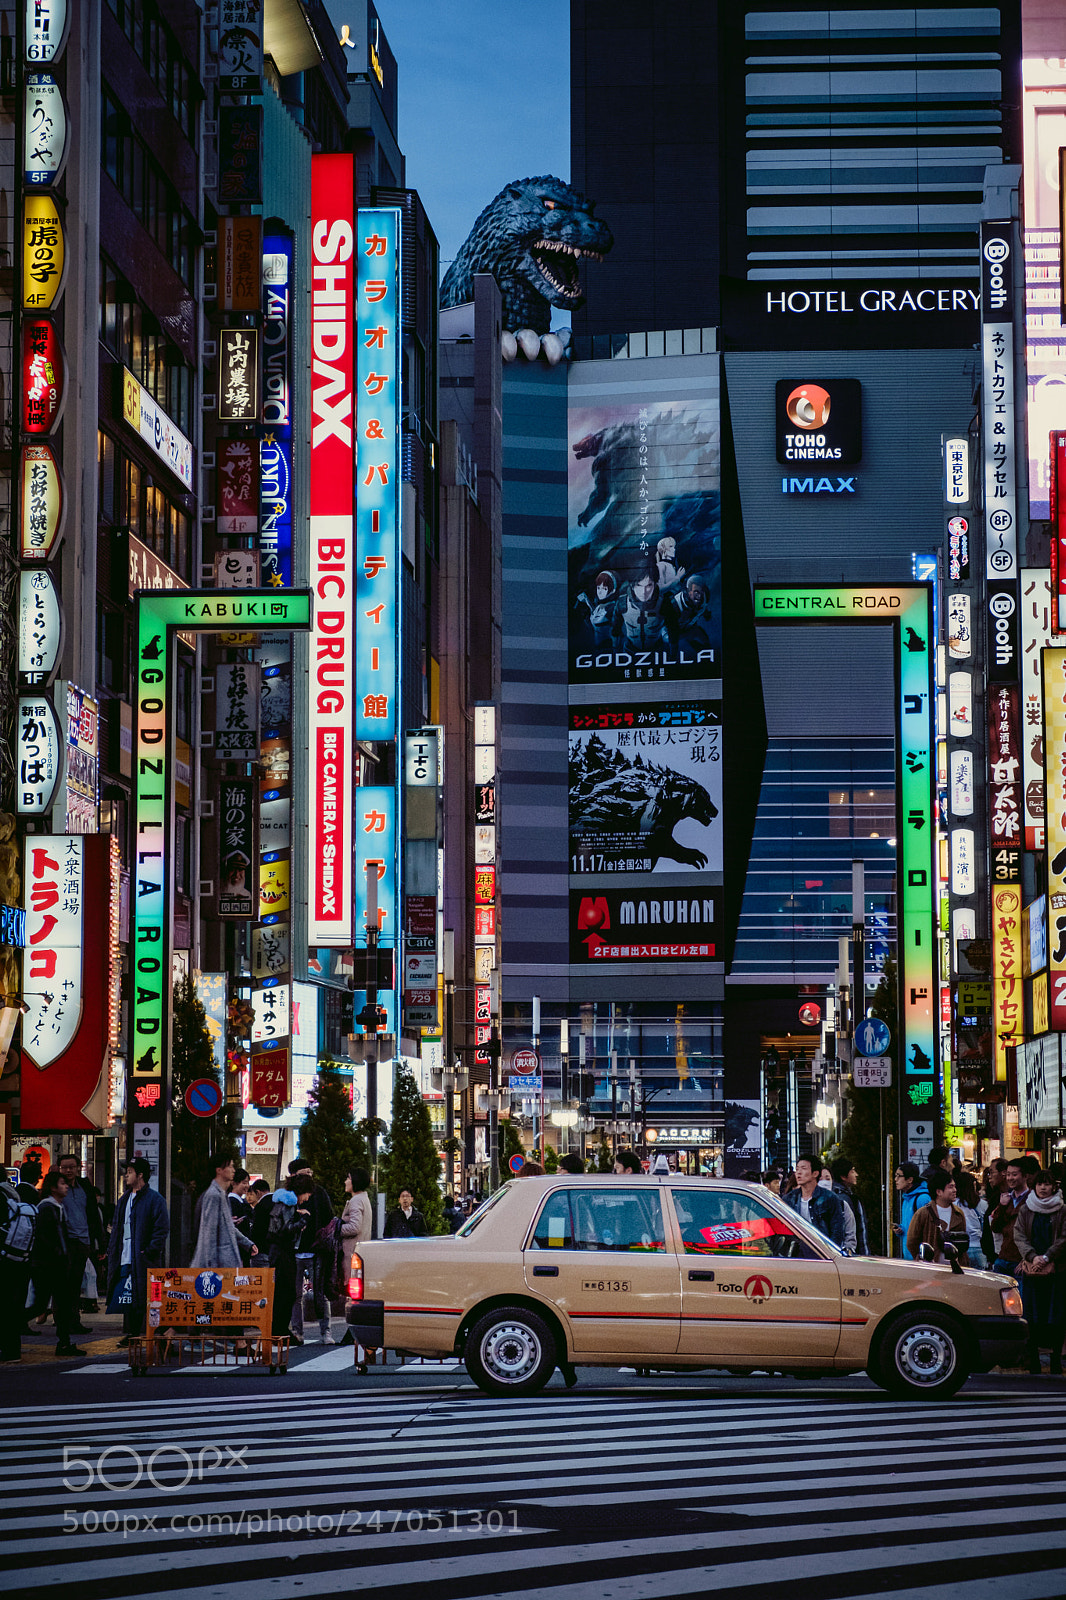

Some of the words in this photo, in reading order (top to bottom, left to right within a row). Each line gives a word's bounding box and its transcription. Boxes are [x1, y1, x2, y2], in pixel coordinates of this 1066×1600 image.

[27, 44, 54, 59] 6F
[231, 76, 247, 88] 8F
[31, 172, 48, 183] 5F
[27, 226, 58, 283] 虎の子
[984, 238, 1009, 309] Booth
[26, 294, 46, 304] 4F
[767, 291, 853, 313] HOTEL
[860, 290, 981, 312] GRACERY
[312, 218, 353, 450] SHIDAX
[224, 332, 250, 407] 山内農場
[992, 332, 1006, 413] ネットカフェ
[126, 380, 137, 420] 3F
[231, 408, 245, 417] 5F
[786, 435, 825, 446] TOHO
[786, 448, 841, 459] CINEMAS
[951, 451, 963, 497] 東京ビル
[993, 441, 1007, 498] カプセル
[782, 478, 855, 492] IMAX
[30, 464, 48, 547] お好み焼き
[228, 518, 247, 531] 4F
[994, 516, 1007, 526] 8F
[317, 538, 345, 600] BIC
[995, 556, 1008, 566] 5F
[762, 596, 846, 609] CENTRAL
[852, 596, 901, 608] ROAD
[30, 594, 47, 667] とらそば
[989, 592, 1015, 665] Booth
[316, 611, 345, 714] DRUG
[575, 649, 715, 668] GODZILLA
[24, 672, 44, 683] 1F
[21, 706, 46, 717] 新宿
[998, 688, 1010, 754] 手作り居酒屋
[323, 733, 338, 760] BIC
[617, 728, 720, 747] 歴代最大ゴジラ
[21, 718, 47, 784] かっぱ
[413, 744, 429, 779] TFC
[690, 746, 720, 762] 現る
[139, 668, 163, 898] GODZILLA
[23, 792, 43, 805] B1
[991, 756, 1020, 838] 甘太郎
[225, 787, 246, 846] 海の家
[903, 693, 928, 1005] ゴジラロード
[996, 851, 1018, 864] 4F
[62, 839, 81, 916] 大衆酒場
[996, 867, 1018, 880] 3F
[477, 874, 493, 899] 麻雀
[29, 848, 59, 979] トラノコ
[620, 900, 714, 924] MARUHAN
[407, 937, 434, 948] Cafe
[594, 946, 709, 957] 2F店舗出入口はビル左側
[136, 926, 161, 1035] ROAD
[51, 979, 75, 1035] やきとり
[411, 995, 431, 1003] 729
[263, 991, 276, 1036] 牛かつ
[516, 1057, 536, 1067] 消火栓
[255, 1071, 284, 1082] アダム
[260, 1093, 280, 1105] イヴ
[597, 1281, 629, 1292] 6135
